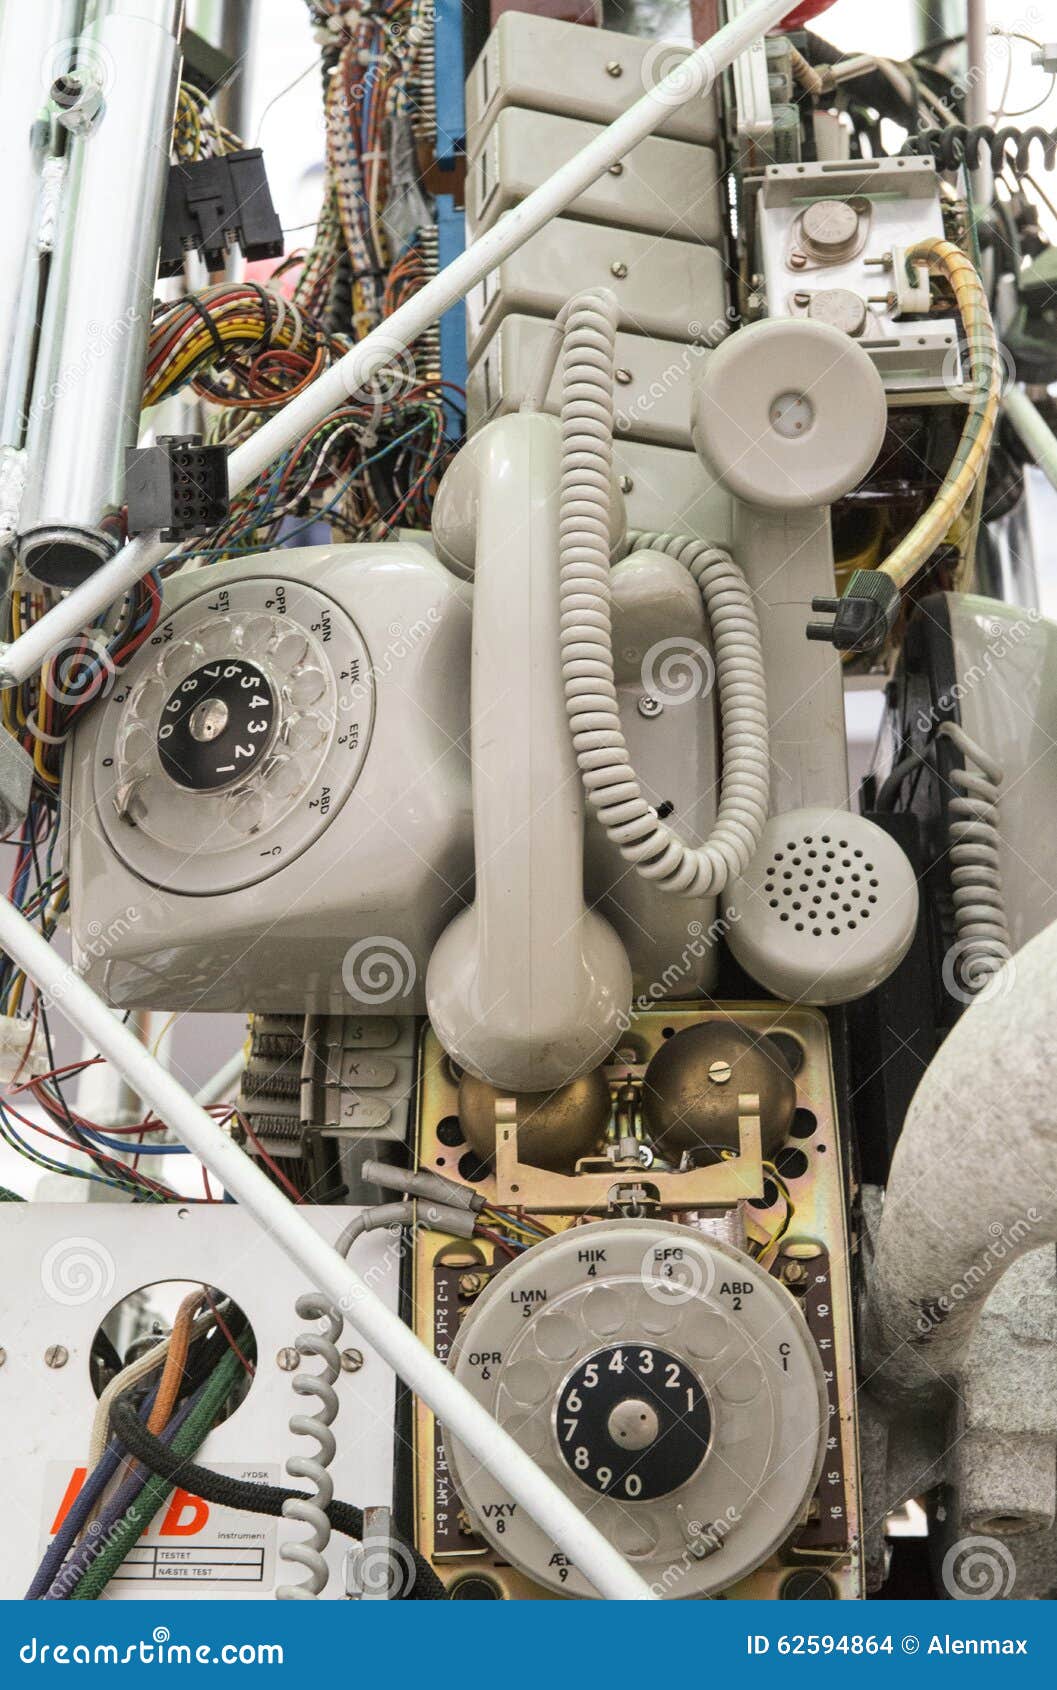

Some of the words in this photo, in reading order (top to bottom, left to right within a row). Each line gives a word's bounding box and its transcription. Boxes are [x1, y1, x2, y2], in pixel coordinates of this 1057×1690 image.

[310, 623, 321, 632] 5
[320, 609, 331, 642] LMN
[203, 666, 220, 678] 7
[223, 665, 242, 678] 6
[339, 671, 349, 680] 4
[350, 659, 360, 685] HIK
[181, 679, 198, 692] 8
[240, 676, 260, 689] 5
[166, 699, 181, 713] 9
[248, 695, 270, 709] 4
[159, 724, 174, 739] 0
[247, 720, 268, 734] 3
[337, 735, 349, 744] 3
[348, 723, 359, 750] EFG
[234, 743, 256, 758] 2
[216, 764, 236, 773] 1
[308, 799, 320, 809] 2
[320, 787, 331, 815] ABD
[271, 846, 282, 856] C
[578, 1249, 607, 1262] HIK
[653, 1248, 684, 1261] EFG
[587, 1264, 597, 1277] 4
[663, 1264, 673, 1277] 3
[720, 1282, 754, 1295] ABD
[511, 1290, 547, 1303] LMN
[732, 1297, 742, 1311] 2
[816, 1303, 829, 1318] 10
[522, 1305, 532, 1318] 5
[779, 1343, 791, 1356] C
[819, 1338, 832, 1350] 11
[468, 1352, 502, 1366] OPR
[608, 1350, 625, 1374] 4
[638, 1350, 654, 1374] 3
[481, 1367, 491, 1380] 6
[582, 1364, 599, 1388] 5
[664, 1363, 681, 1388] 2
[566, 1388, 583, 1412] 6
[686, 1387, 694, 1412] 1
[563, 1419, 579, 1442] 7
[826, 1436, 838, 1450] 14
[574, 1446, 590, 1470] 8
[241, 1471, 269, 1479] JYDSK
[596, 1466, 612, 1490] 9
[827, 1471, 840, 1486] 15
[624, 1474, 642, 1497] 0
[482, 1503, 517, 1518] VXY
[830, 1505, 843, 1520] 16
[436, 1513, 448, 1536] 8-T
[496, 1519, 506, 1534] 8
[160, 1552, 191, 1560] TESTET
[158, 1568, 188, 1576] NÆSTE
[192, 1568, 213, 1576] TEST
[559, 1568, 569, 1583] 9
